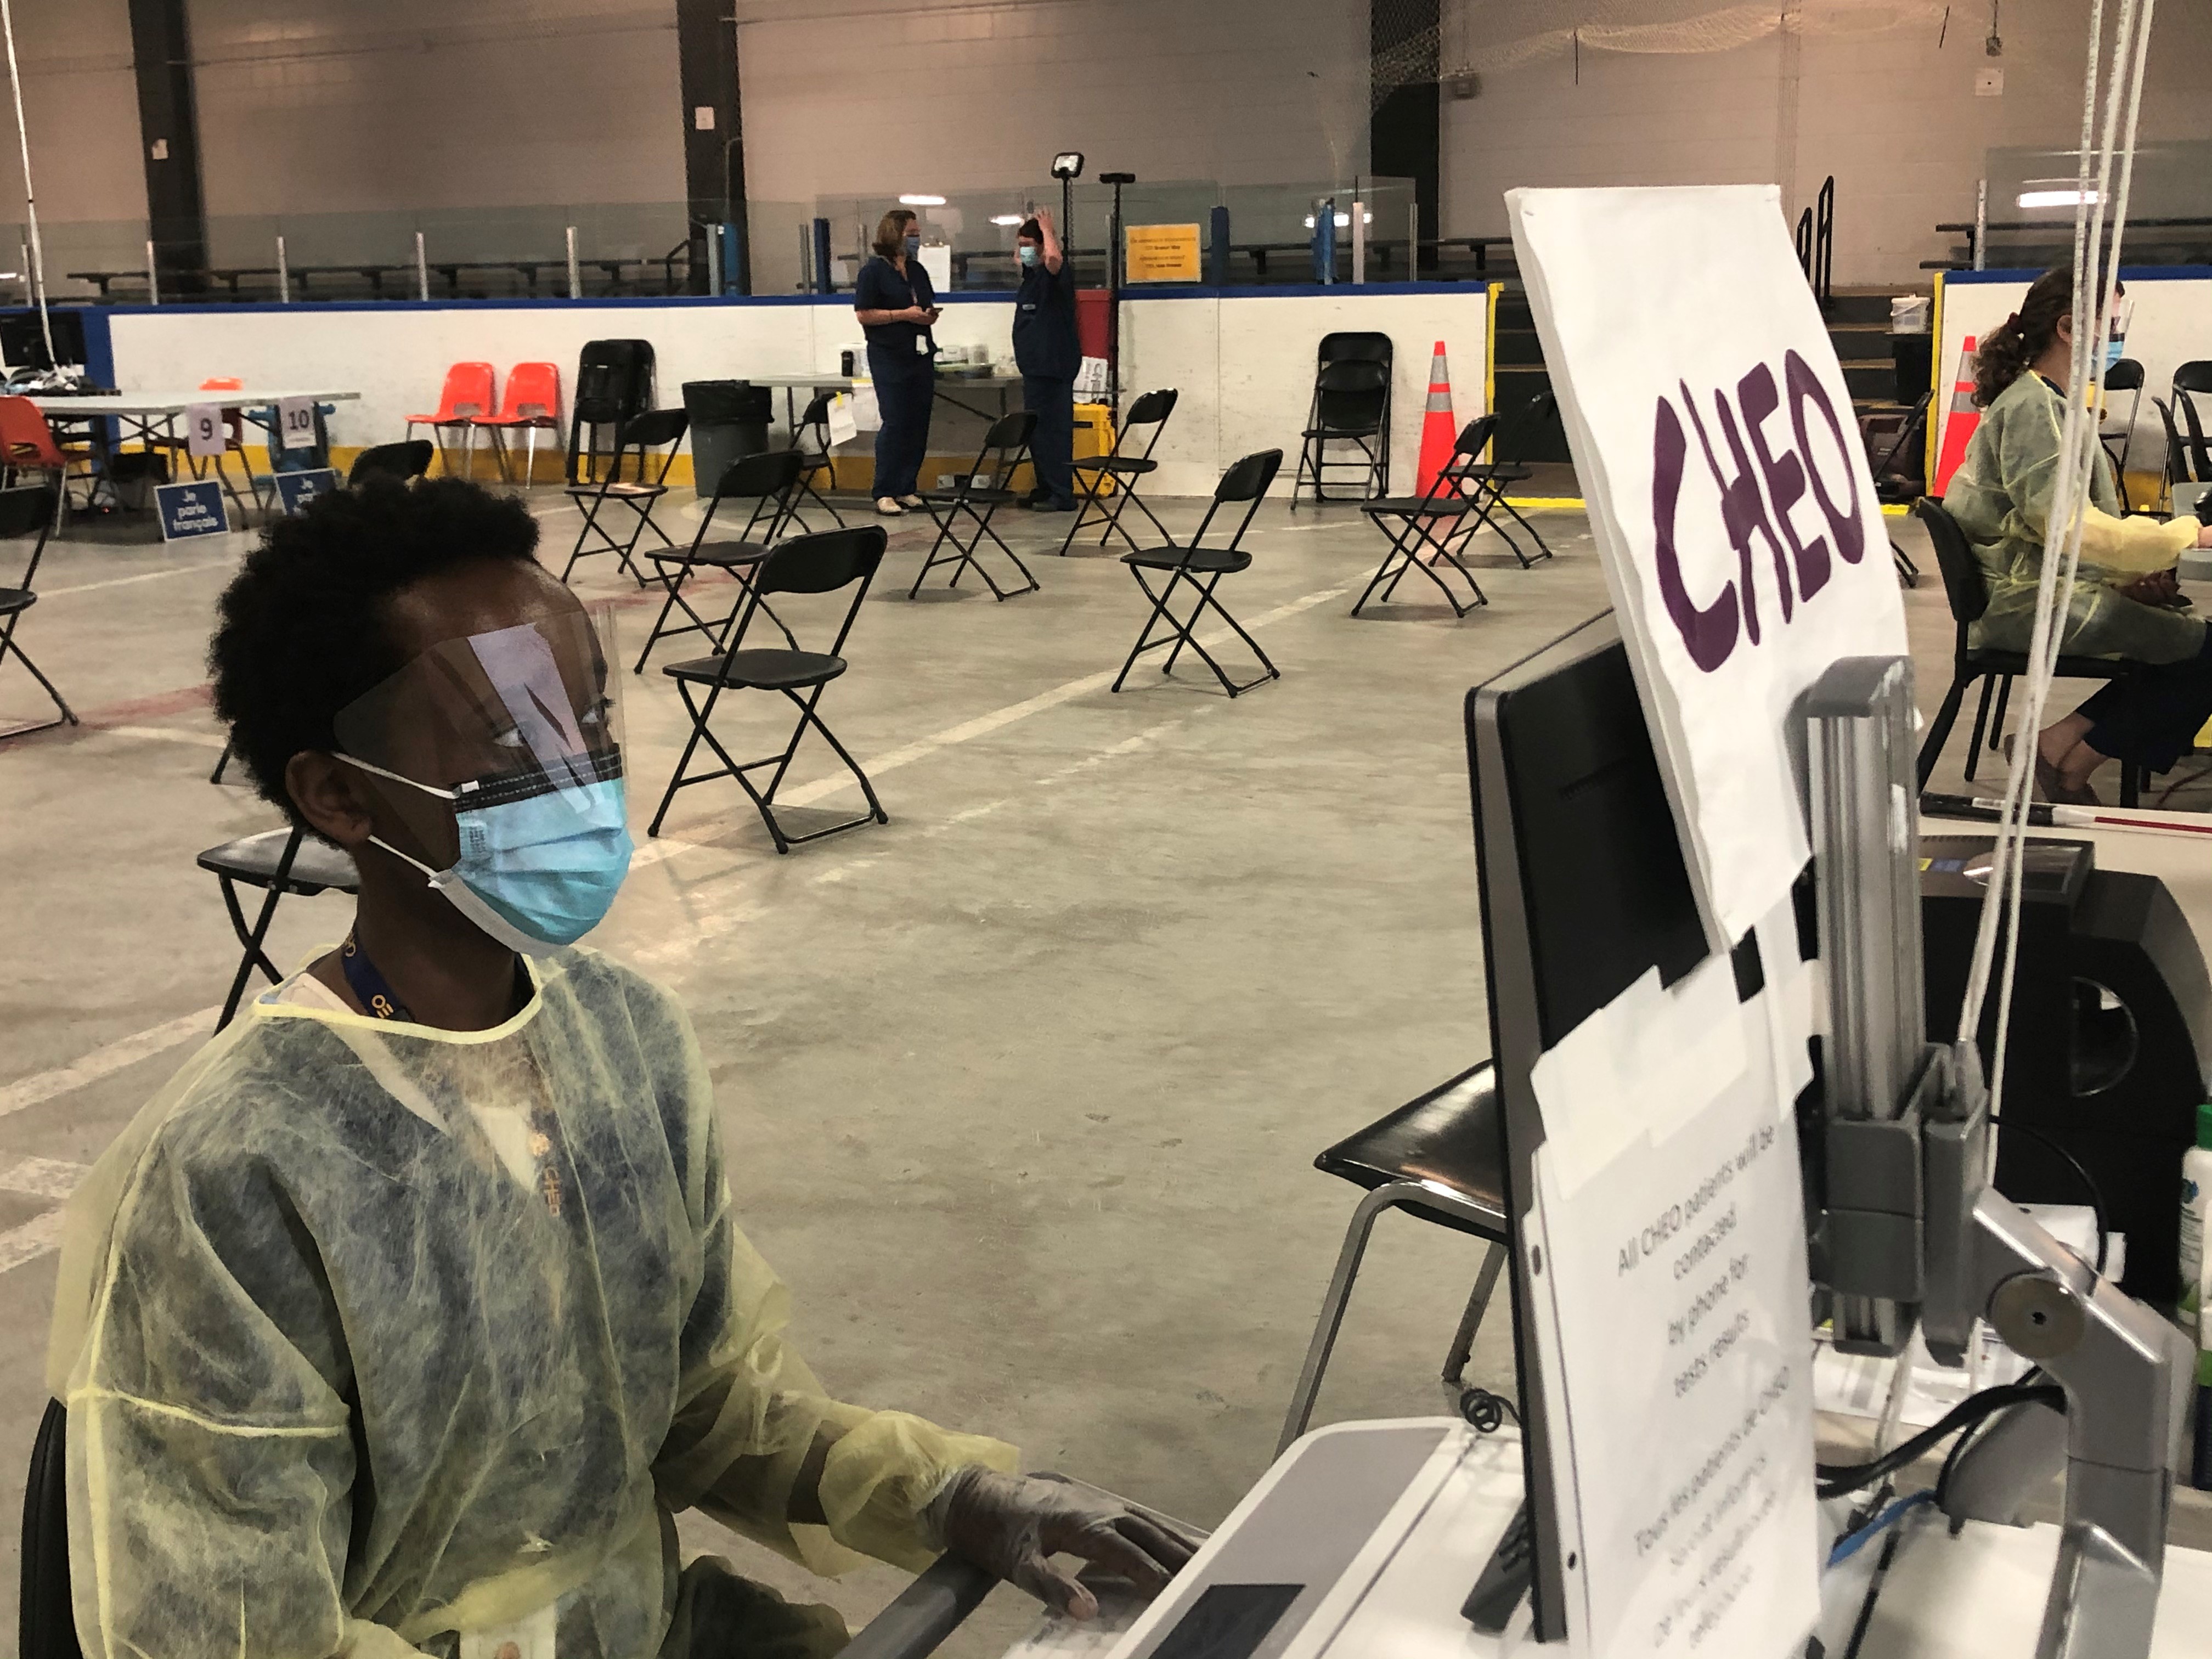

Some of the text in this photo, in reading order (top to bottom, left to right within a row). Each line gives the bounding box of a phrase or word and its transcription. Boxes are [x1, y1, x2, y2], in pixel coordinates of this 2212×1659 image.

[200, 417, 213, 441] 9
[289, 410, 309, 430] 10
[177, 503, 207, 520] parle
[182, 489, 196, 503] Je
[1652, 349, 1864, 673] CHEO
[172, 516, 219, 532] français
[1618, 1125, 1775, 1278] All CHEO patients will be
[1673, 1200, 1737, 1280] contacted
[1668, 1253, 1751, 1346] by phone for
[1709, 1308, 1751, 1363] results
